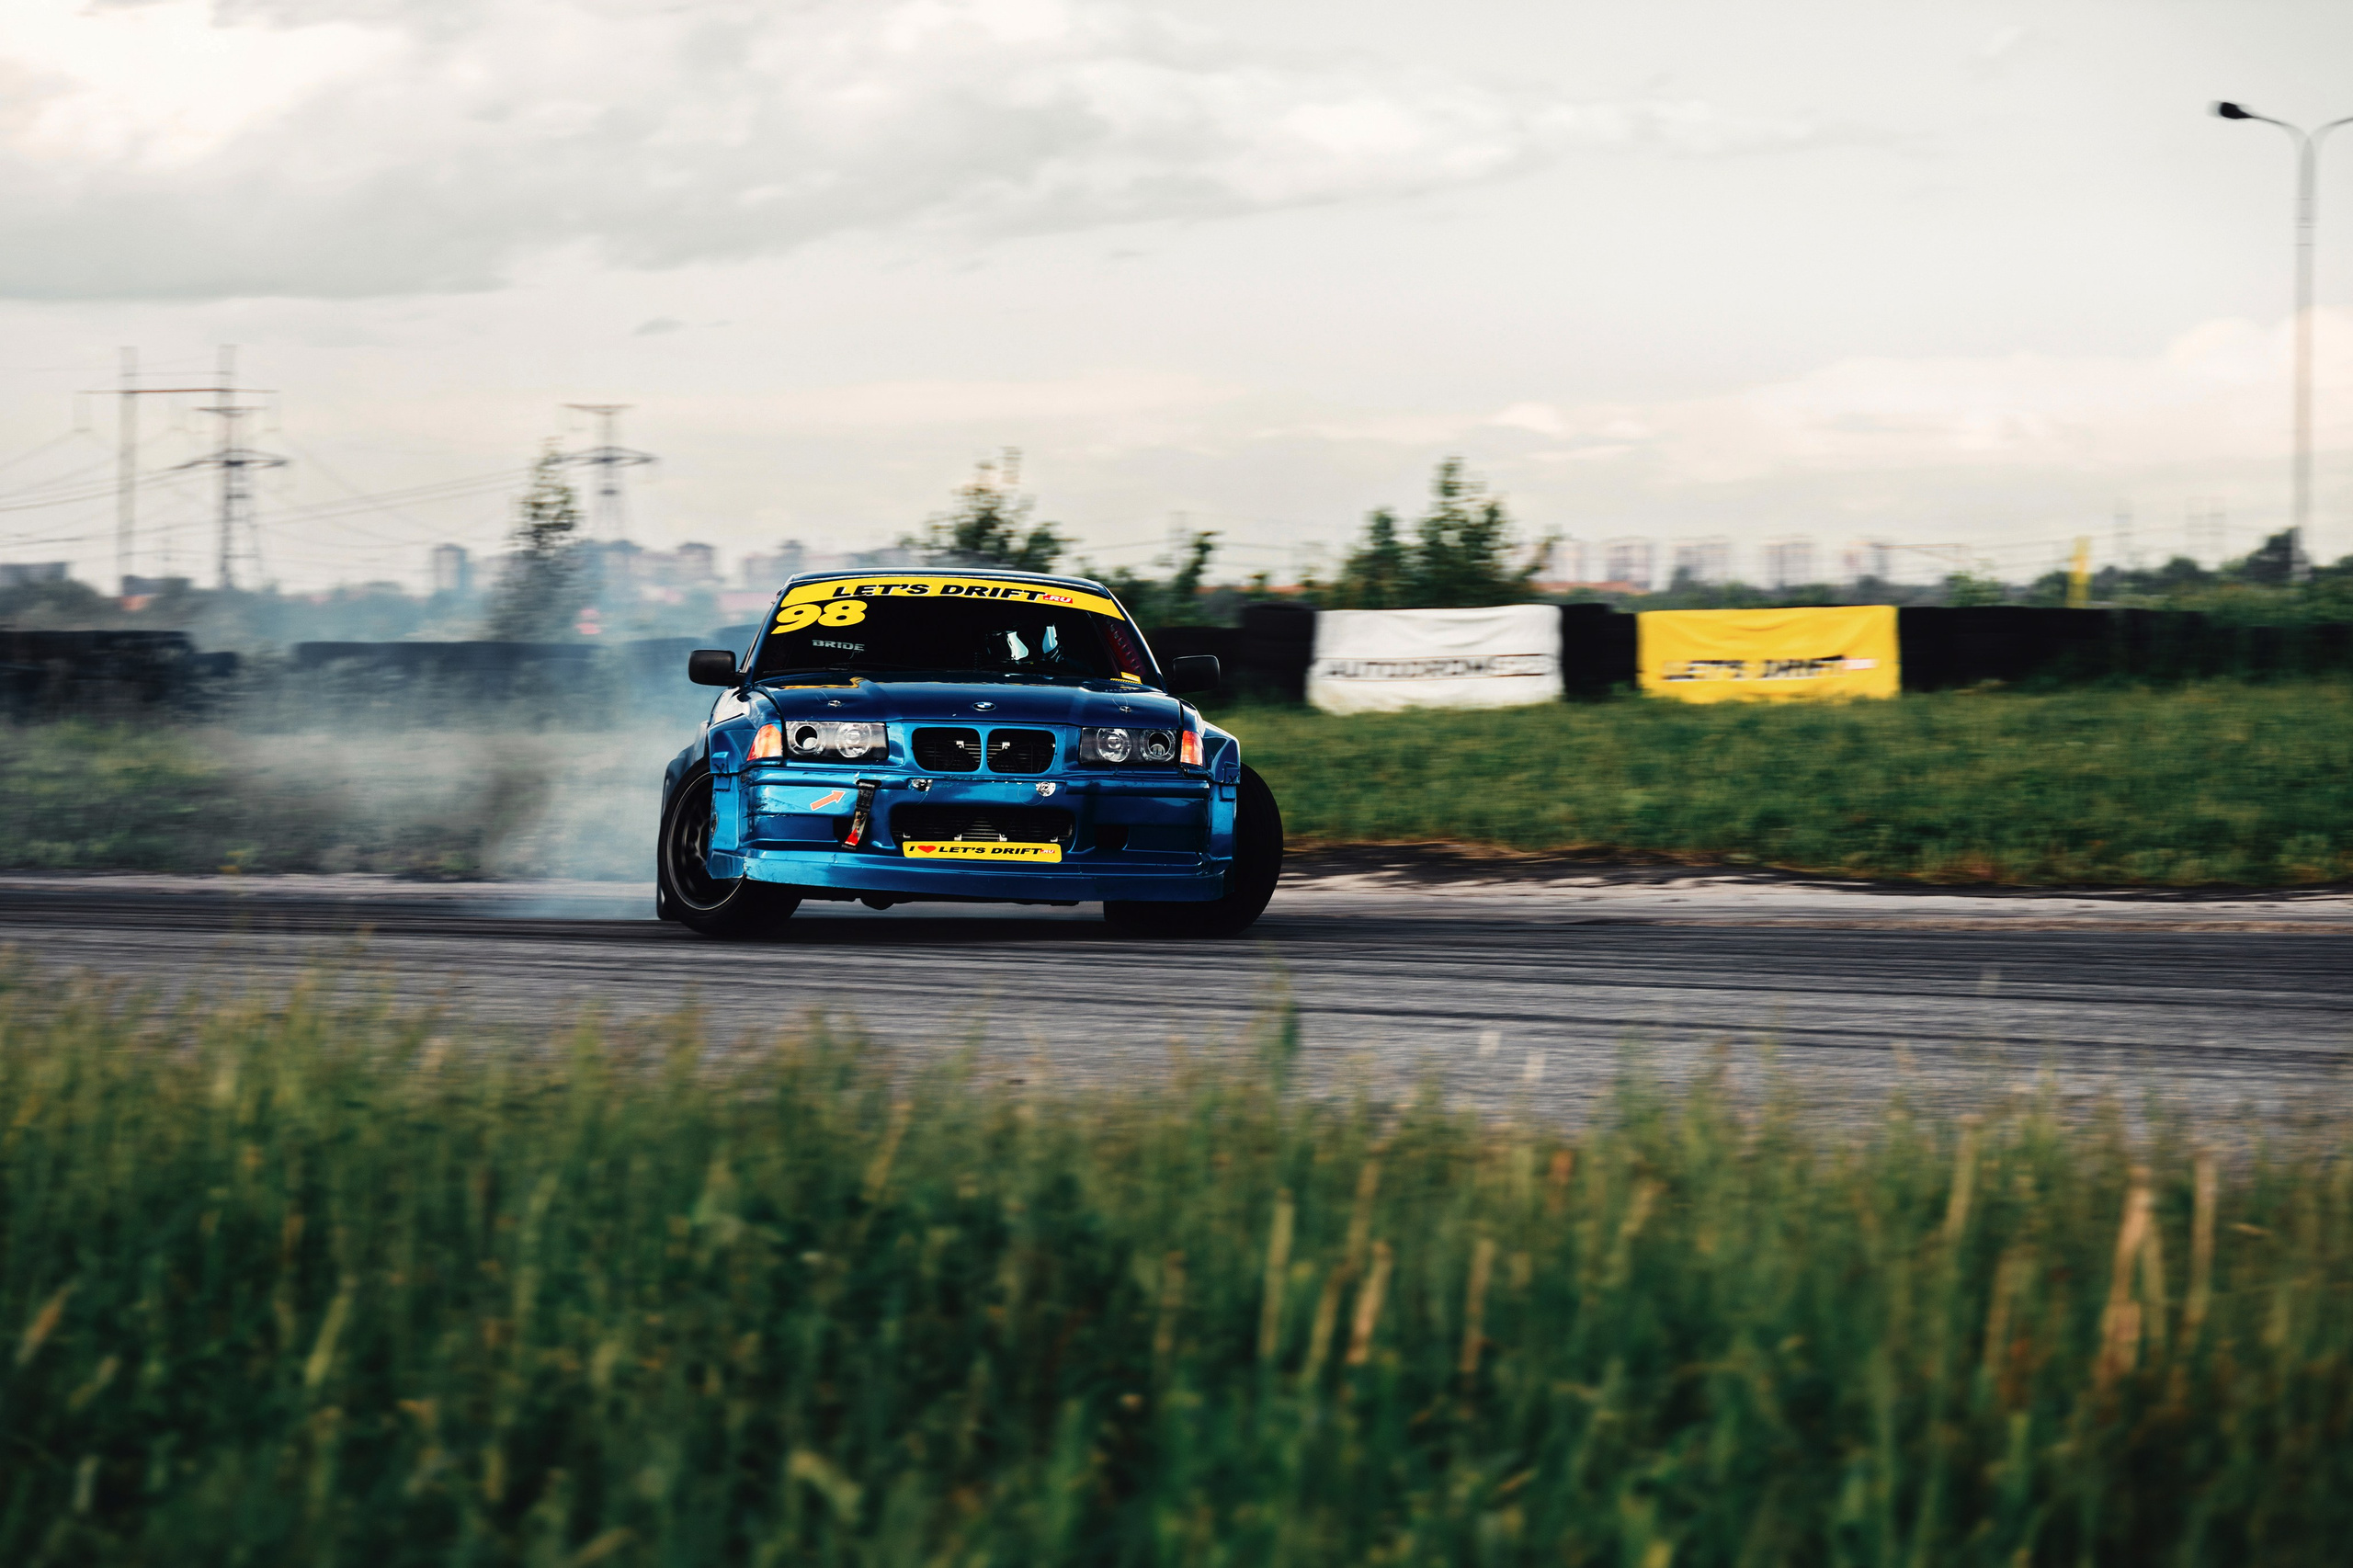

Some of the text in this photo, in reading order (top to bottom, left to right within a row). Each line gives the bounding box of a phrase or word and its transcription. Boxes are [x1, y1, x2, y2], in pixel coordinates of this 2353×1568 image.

[832, 584, 930, 597] LET'S
[770, 599, 868, 634] 98
[812, 640, 865, 651] BRIDE
